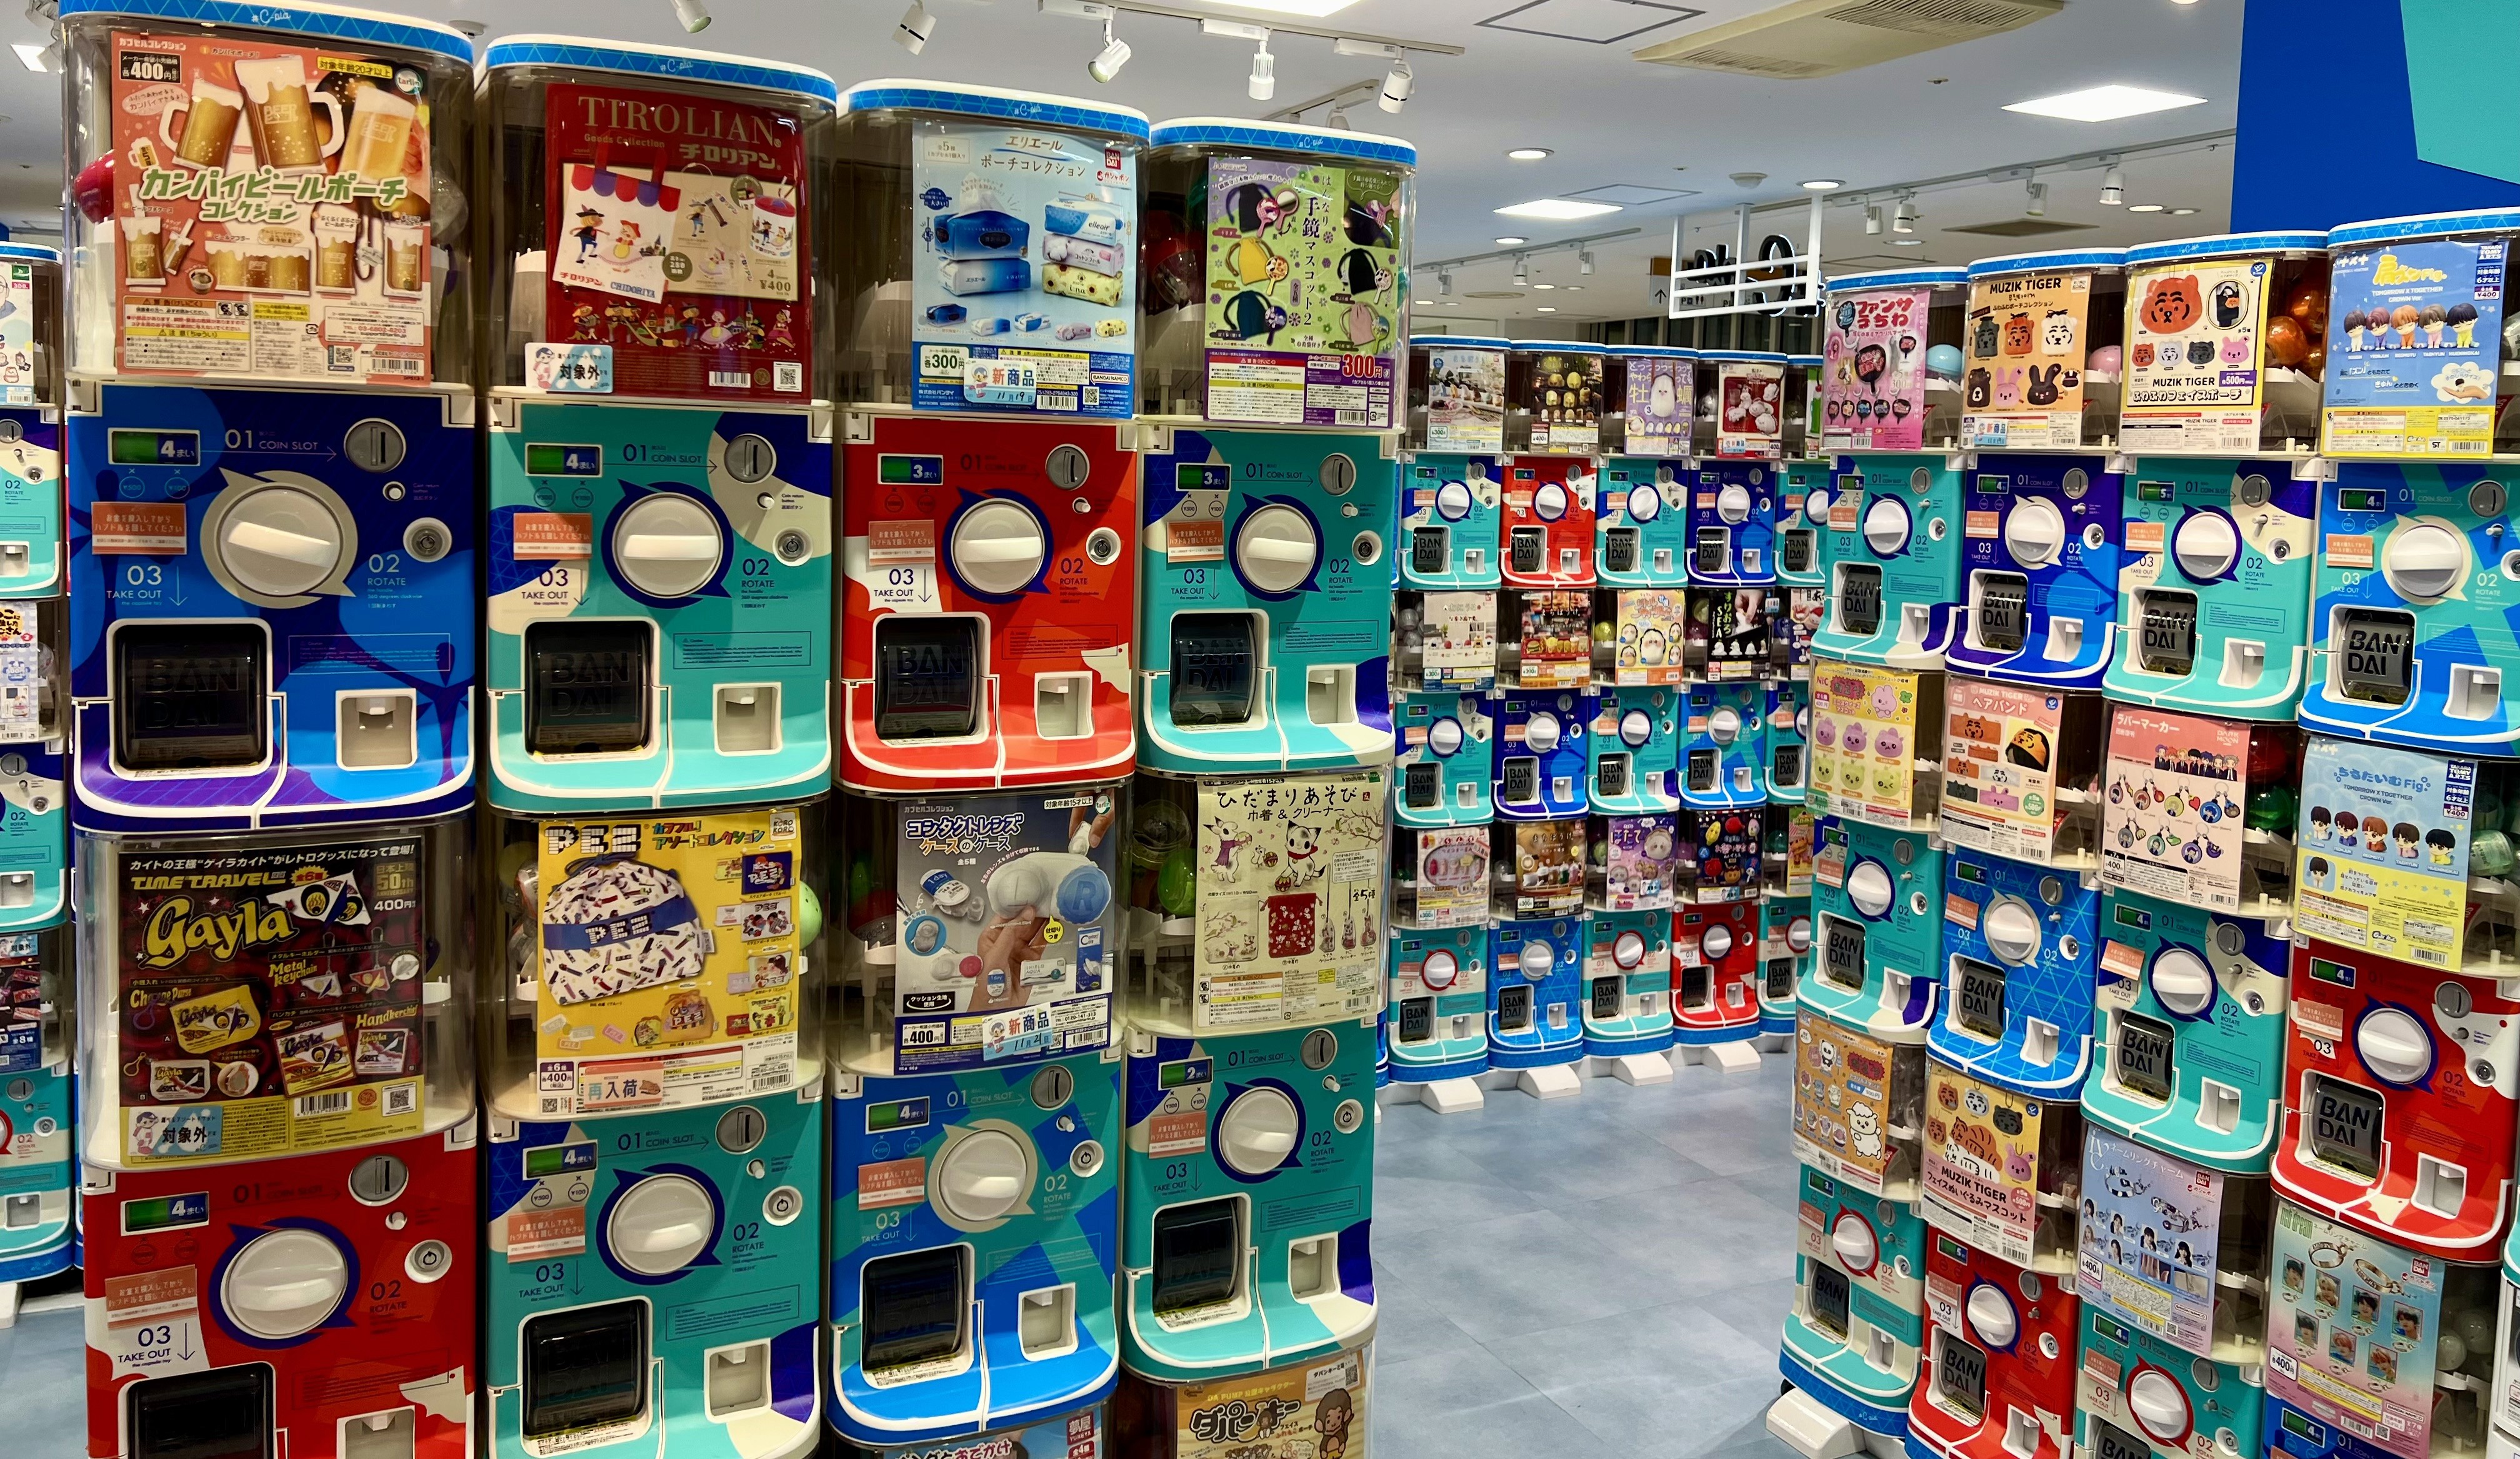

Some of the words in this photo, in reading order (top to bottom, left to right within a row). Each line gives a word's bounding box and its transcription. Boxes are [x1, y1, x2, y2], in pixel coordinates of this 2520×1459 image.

[578, 95, 775, 148] TIROLIAN
[584, 133, 614, 144] Goods
[616, 137, 665, 149] Collection
[1006, 135, 1063, 150] エリエール
[678, 143, 777, 169] チロリアン
[981, 154, 1086, 177] ポーチコレクション
[139, 168, 408, 206] カンパイビールポーチ
[199, 200, 299, 221] コレクション
[1088, 221, 1110, 231] elleair
[1301, 196, 1321, 326] 手鏡マスコット2
[559, 271, 602, 286] チロリアン
[759, 279, 791, 293] ¥400
[1989, 281, 2022, 294] MUZIK
[2025, 278, 2061, 290] TIGER
[610, 280, 656, 299] CHIDORIYA
[2372, 289, 2404, 297] TOMORROW
[1856, 298, 1914, 314] ファンサ
[1858, 313, 1909, 329] うちわ
[559, 364, 600, 380] 対象外
[1342, 353, 1382, 378] 300円
[992, 368, 1034, 387] 新商品
[2152, 378, 2182, 387] MUZIK
[2185, 377, 2215, 386] TIGER
[2133, 388, 2242, 402] ふわふわフェイスポーチ
[224, 429, 252, 449] 01
[258, 441, 288, 450] COIN
[292, 441, 318, 451] SLOT
[623, 444, 647, 463] 01
[651, 453, 676, 464] COIN
[679, 453, 702, 464] SLOT
[5, 479, 21, 491] 02
[1418, 537, 1442, 549] BAN
[1418, 549, 1438, 560] DAI
[368, 554, 400, 573] 02
[742, 559, 769, 576] 02
[1329, 559, 1349, 573] 02
[127, 566, 162, 585] 03
[367, 577, 406, 586] ROTATE
[741, 579, 774, 589] ROTATE
[1184, 569, 1206, 584] 03
[106, 590, 134, 599] TAKE
[138, 589, 162, 599] OUT
[521, 591, 545, 600] TAKE
[548, 591, 568, 600] OUT
[2348, 629, 2402, 654] BAN
[2347, 653, 2388, 676] DAI
[1816, 676, 1829, 686] NIC
[1979, 687, 2000, 696] MUZIK
[2002, 690, 2024, 699] TIGER
[1973, 697, 2028, 716] ヘアバンド
[2116, 713, 2180, 733] ラバーマーカー
[2217, 730, 2239, 738] DARK
[1509, 766, 1531, 780] BAN
[2338, 766, 2402, 786] ちるたいむ
[2449, 768, 2471, 776] TOMY
[1508, 777, 1527, 790] DAI
[1218, 785, 1358, 808] ひだまりあそび
[2343, 784, 2375, 795] TOMORROW
[2381, 791, 2413, 801] TOGETHER
[2359, 795, 2381, 803] CROWN
[2446, 795, 2469, 804] 6才以上
[1046, 798, 1092, 808] 対象年齢15才以上
[1248, 810, 1272, 821] 巾着
[1278, 809, 1288, 820] &
[1292, 806, 1345, 819] クリーナー
[652, 820, 701, 834] カラフル!
[906, 813, 1024, 838] コンタクトレンズ
[544, 823, 642, 855] PEZ
[652, 830, 765, 850] アソートコレクション
[919, 836, 1011, 856] ケースのケース
[130, 876, 182, 891] TIME
[189, 873, 286, 889] TRAVEL
[1072, 880, 1096, 910] R
[138, 895, 299, 970] Gayla
[584, 915, 654, 945] PEZ
[1046, 926, 1061, 935] 仕切り
[1830, 929, 1860, 954] BAN
[1829, 948, 1851, 968] DAI
[269, 960, 306, 977] Metal
[274, 964, 317, 987] keychain
[1596, 984, 1618, 998] BAN
[1596, 996, 1616, 1008] DAI
[670, 1011, 706, 1026] PEZ
[1008, 1011, 1049, 1035] 新商品
[588, 1079, 638, 1101] 再入荷
[2319, 1096, 2371, 1129] BAN
[162, 1126, 208, 1144] 対象外
[1311, 1131, 1331, 1146] 02
[2318, 1121, 2357, 1148] DAI
[1941, 1166, 1972, 1188] MUZIK
[1974, 1181, 2006, 1203] TIGER
[1927, 1171, 2027, 1223] フェイスぬいぐるみマスコット
[1069, 1415, 1091, 1435] 夢屋
[1280, 1420, 1299, 1430] フェイス
